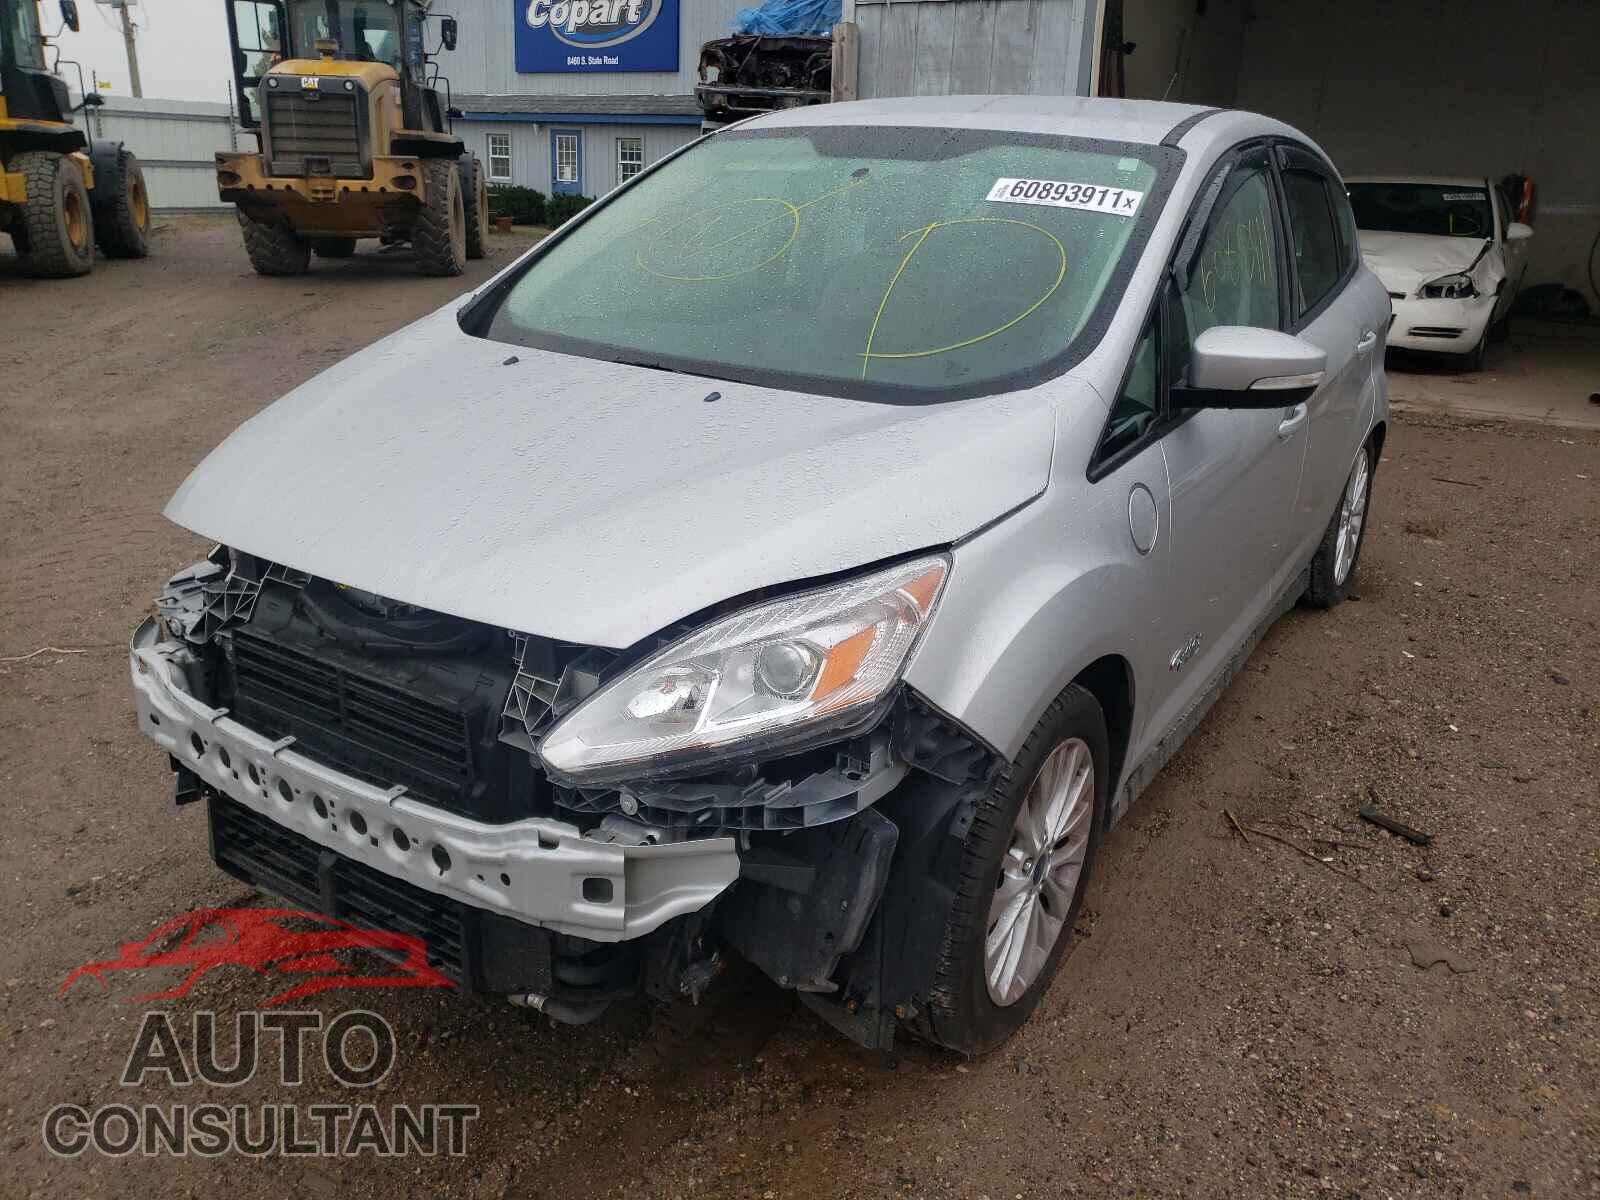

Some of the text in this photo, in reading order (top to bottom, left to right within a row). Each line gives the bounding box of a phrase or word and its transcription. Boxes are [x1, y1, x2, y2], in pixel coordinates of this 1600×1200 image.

[527, 0, 642, 34] Copart
[588, 56, 602, 65] State
[604, 56, 618, 65] Road
[301, 77, 320, 89] CAT
